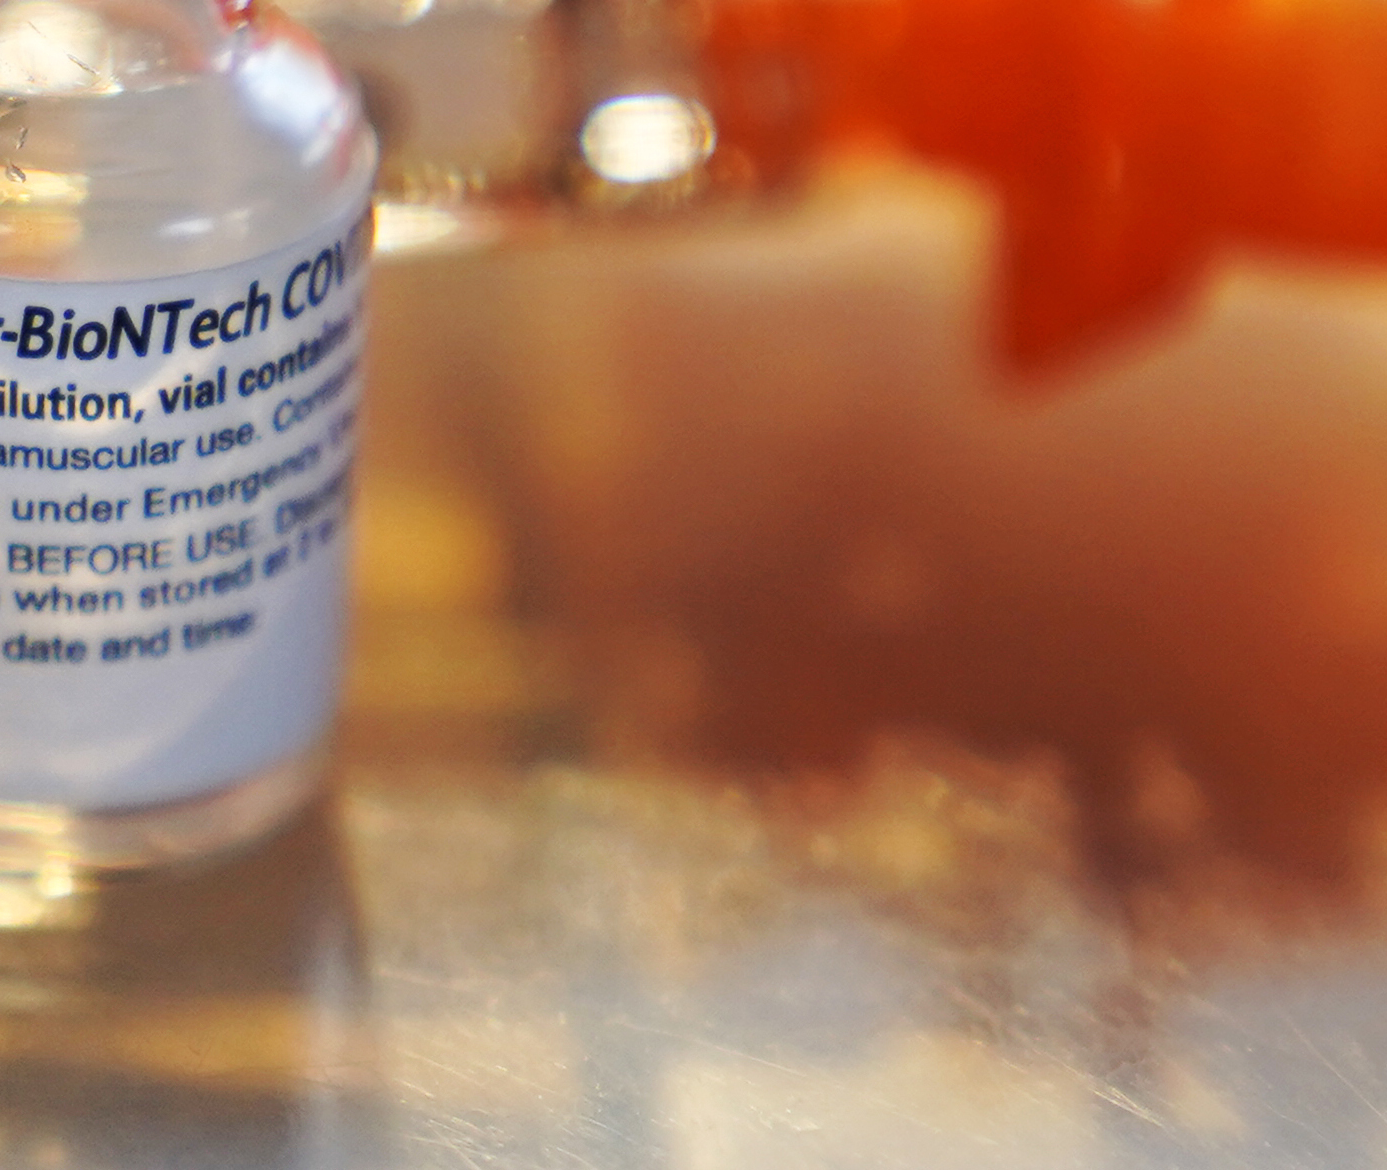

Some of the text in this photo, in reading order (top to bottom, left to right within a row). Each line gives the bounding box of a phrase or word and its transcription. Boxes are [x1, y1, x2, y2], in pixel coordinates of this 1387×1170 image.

[158, 365, 227, 415] vial
[12, 494, 131, 523] under
[7, 540, 175, 575] BEFORE
[13, 584, 125, 614] when
